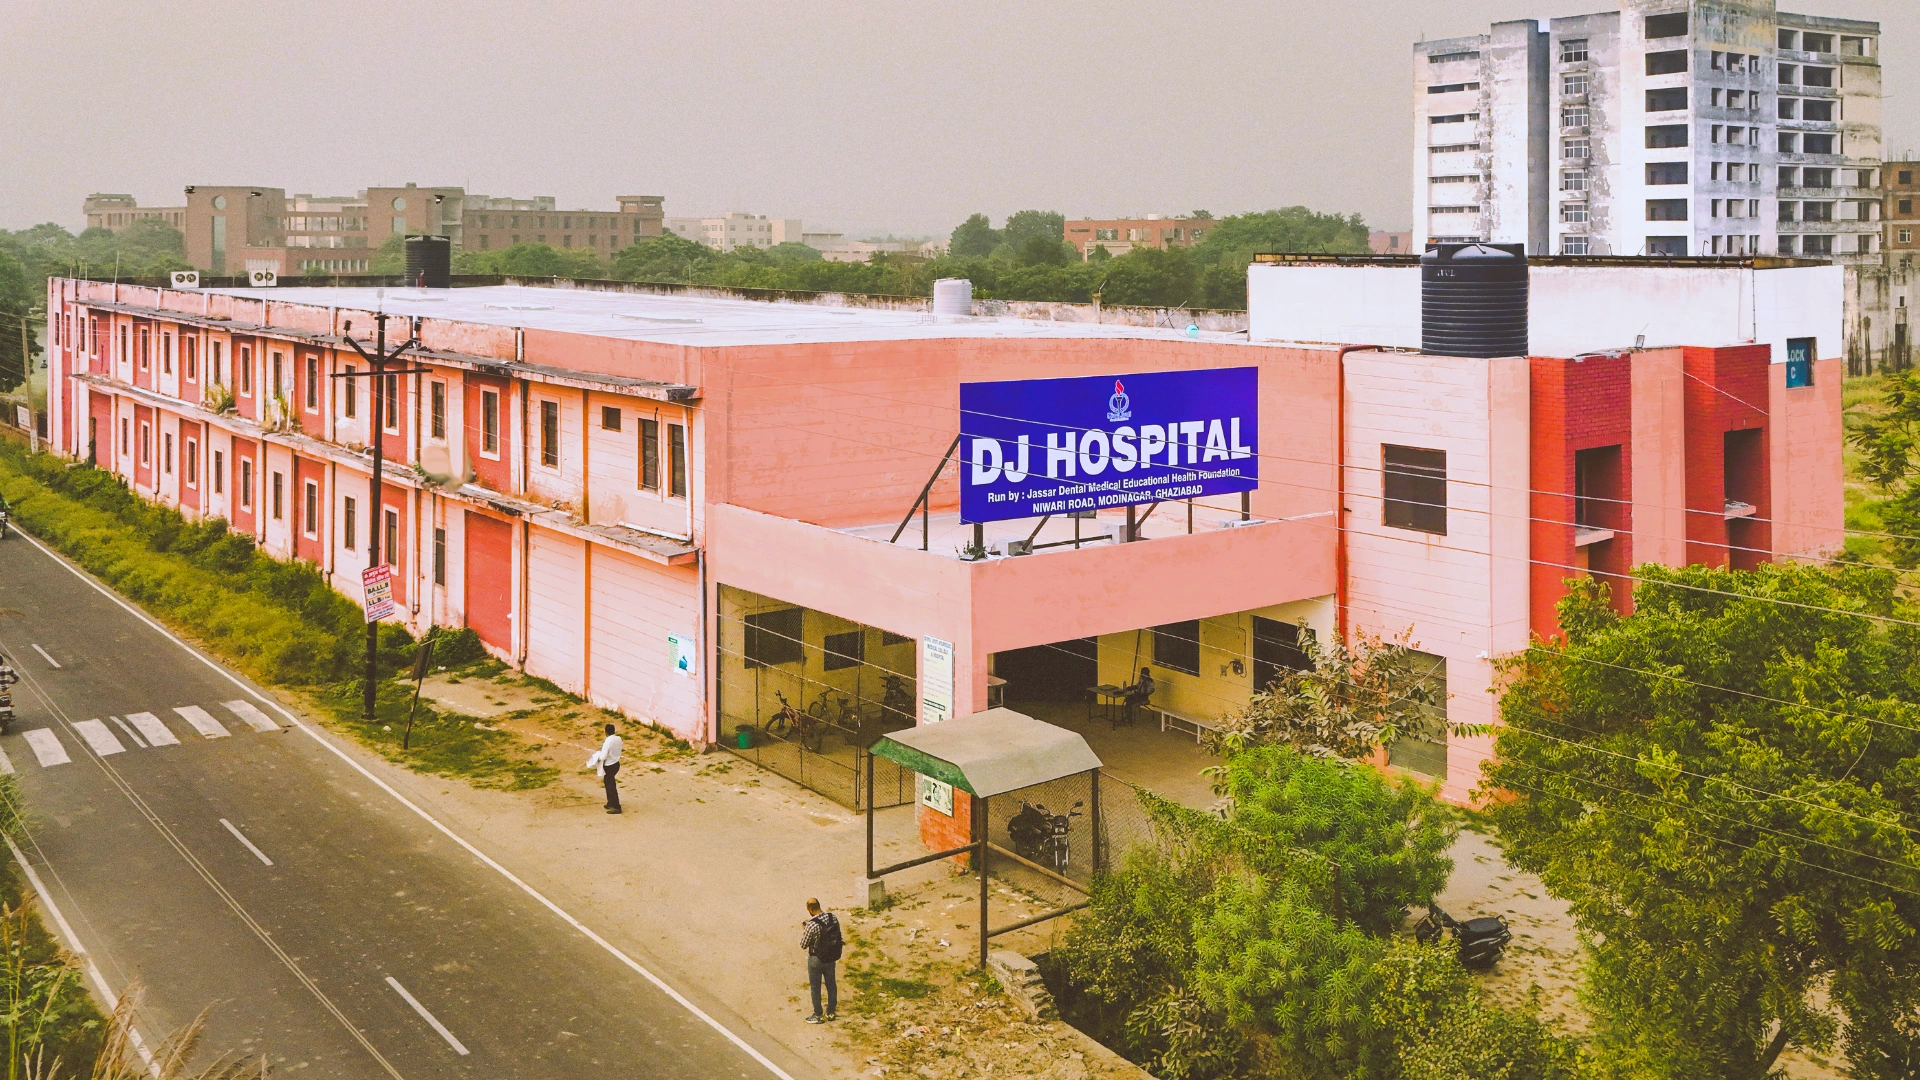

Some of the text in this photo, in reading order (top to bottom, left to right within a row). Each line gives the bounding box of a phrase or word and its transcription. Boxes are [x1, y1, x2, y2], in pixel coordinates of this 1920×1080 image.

[1790, 366, 1796, 379] C
[971, 417, 1251, 486] DJ HOSPITAL
[987, 492, 1006, 503] Run
[1008, 491, 1020, 503] by
[1027, 488, 1056, 499] Jassar
[1059, 484, 1086, 496] Dental
[1088, 480, 1121, 492] Medical
[1123, 474, 1170, 488] Educational
[1171, 472, 1197, 483] Health
[1198, 467, 1240, 480] Foundation
[1032, 485, 1203, 513] NIWARI ROAD, MODINAGAR, GHAZIABAD
